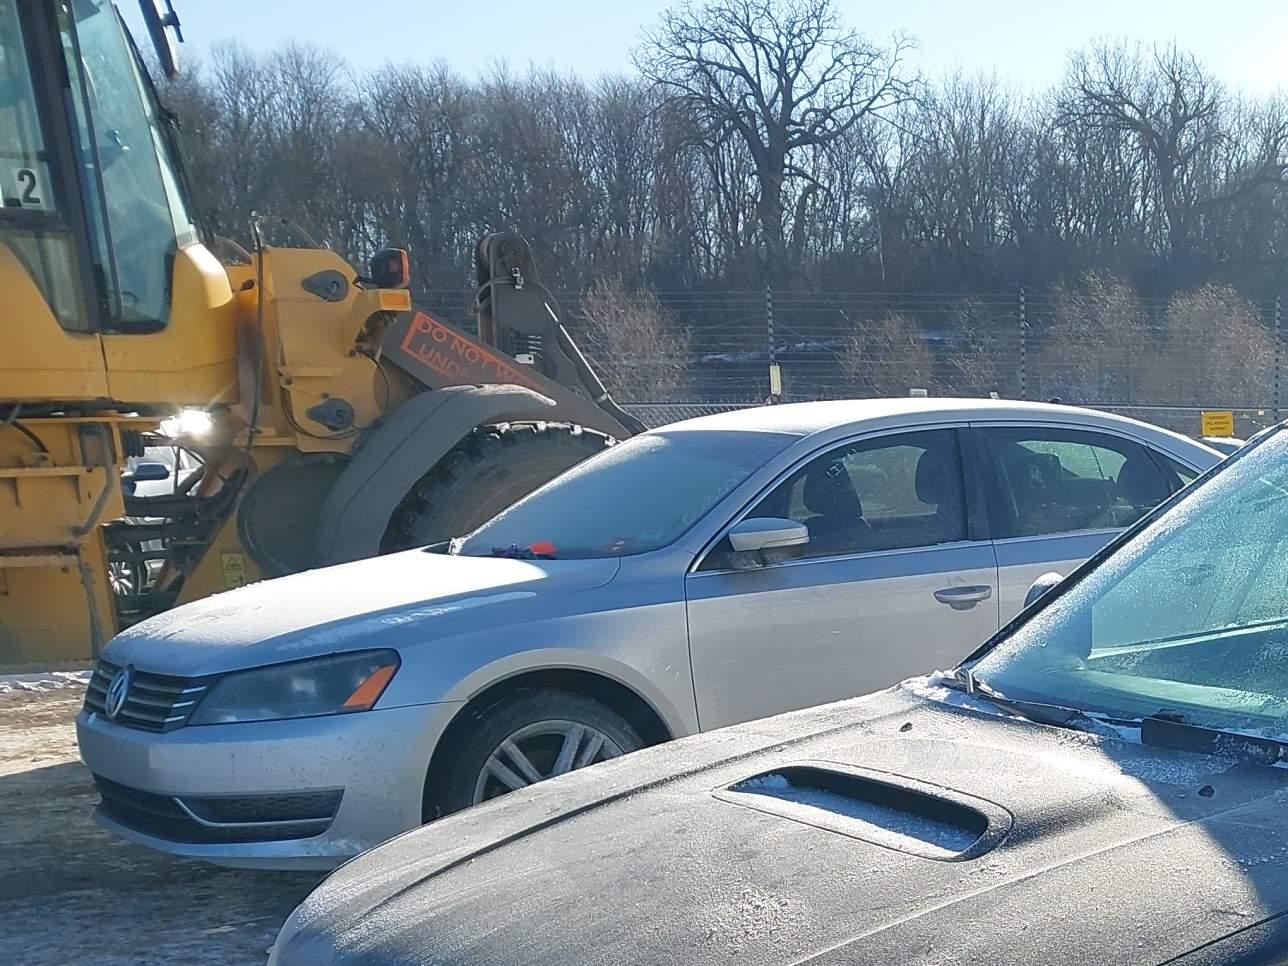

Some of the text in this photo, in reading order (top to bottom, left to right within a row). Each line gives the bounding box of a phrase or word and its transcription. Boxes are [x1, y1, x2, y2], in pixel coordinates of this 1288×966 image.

[17, 168, 41, 204] 2
[416, 319, 491, 369] DO NOT
